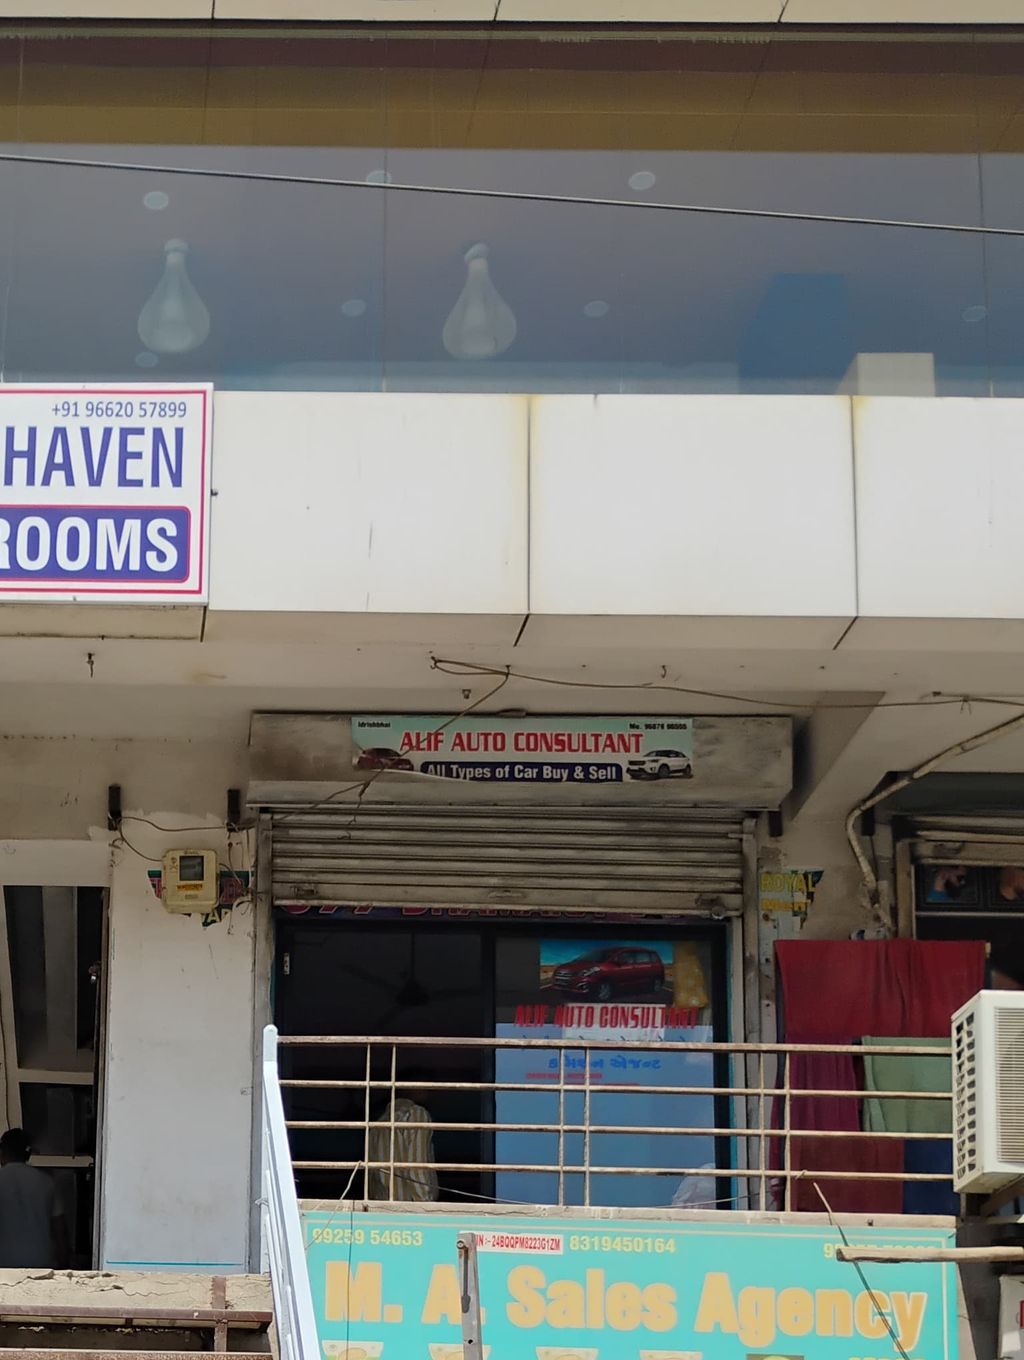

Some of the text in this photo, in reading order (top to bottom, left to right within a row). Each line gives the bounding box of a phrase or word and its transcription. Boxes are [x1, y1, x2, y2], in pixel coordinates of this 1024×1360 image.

[51, 401, 187, 419] +91 96620 57899
[4, 425, 184, 489] HAVEN
[400, 731, 643, 753] ALIF AUTO CONSULTANT
[427, 764, 616, 782] All Types of Car Buy & Sell
[514, 1004, 699, 1030] ALIF AUTO CONSULTANT
[370, 1229, 423, 1246] 54653
[569, 1235, 676, 1254] 8319450164
[325, 1260, 404, 1323] M.
[507, 1264, 678, 1333] Sales
[694, 1271, 928, 1352] Agency
